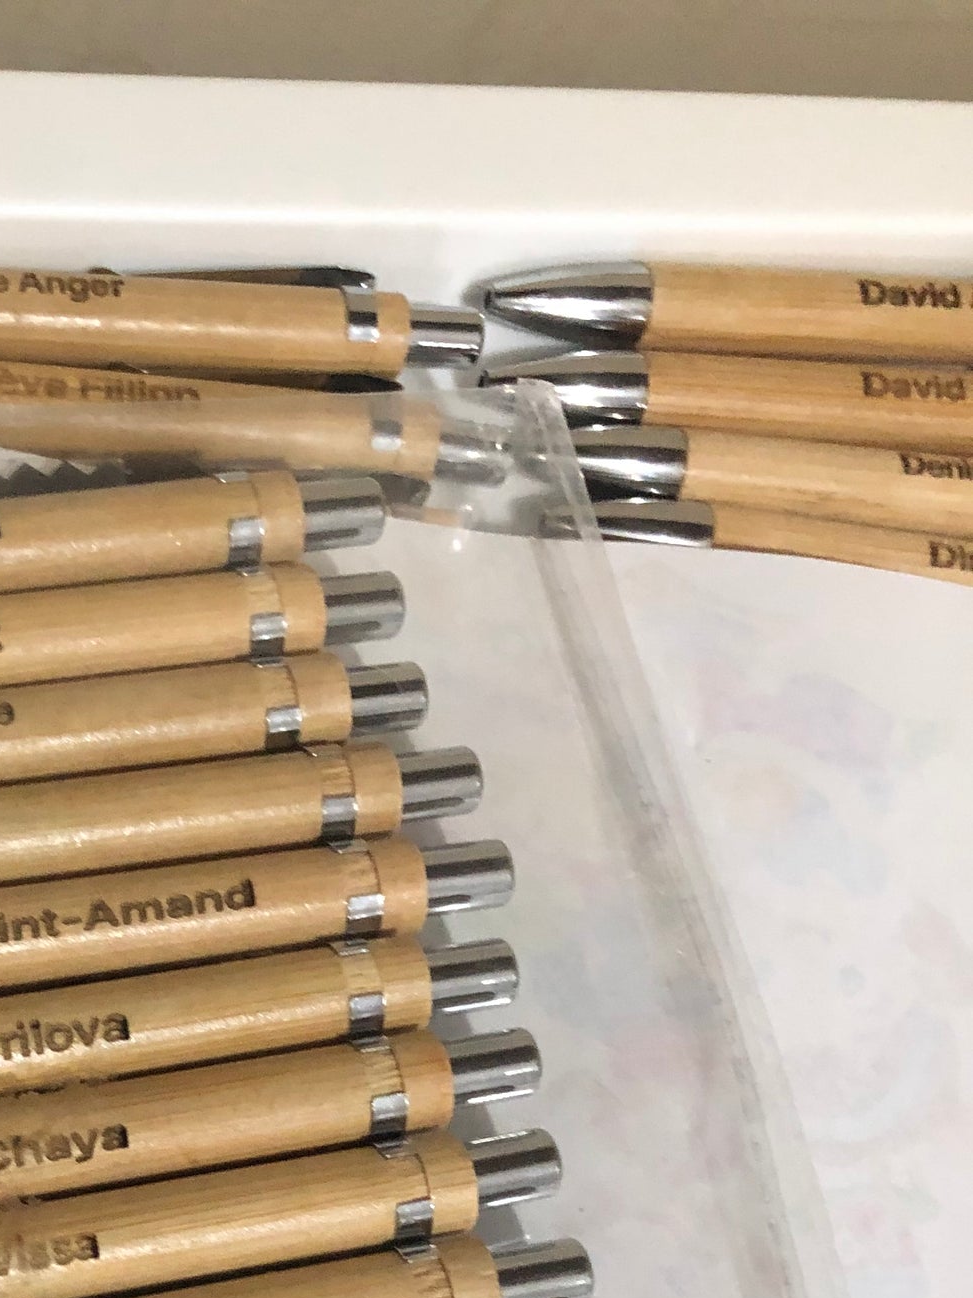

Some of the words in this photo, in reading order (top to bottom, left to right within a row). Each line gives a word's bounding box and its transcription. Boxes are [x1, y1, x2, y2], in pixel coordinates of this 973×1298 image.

[18, 271, 125, 303] Anger
[858, 278, 962, 309] David
[860, 371, 966, 402] David
